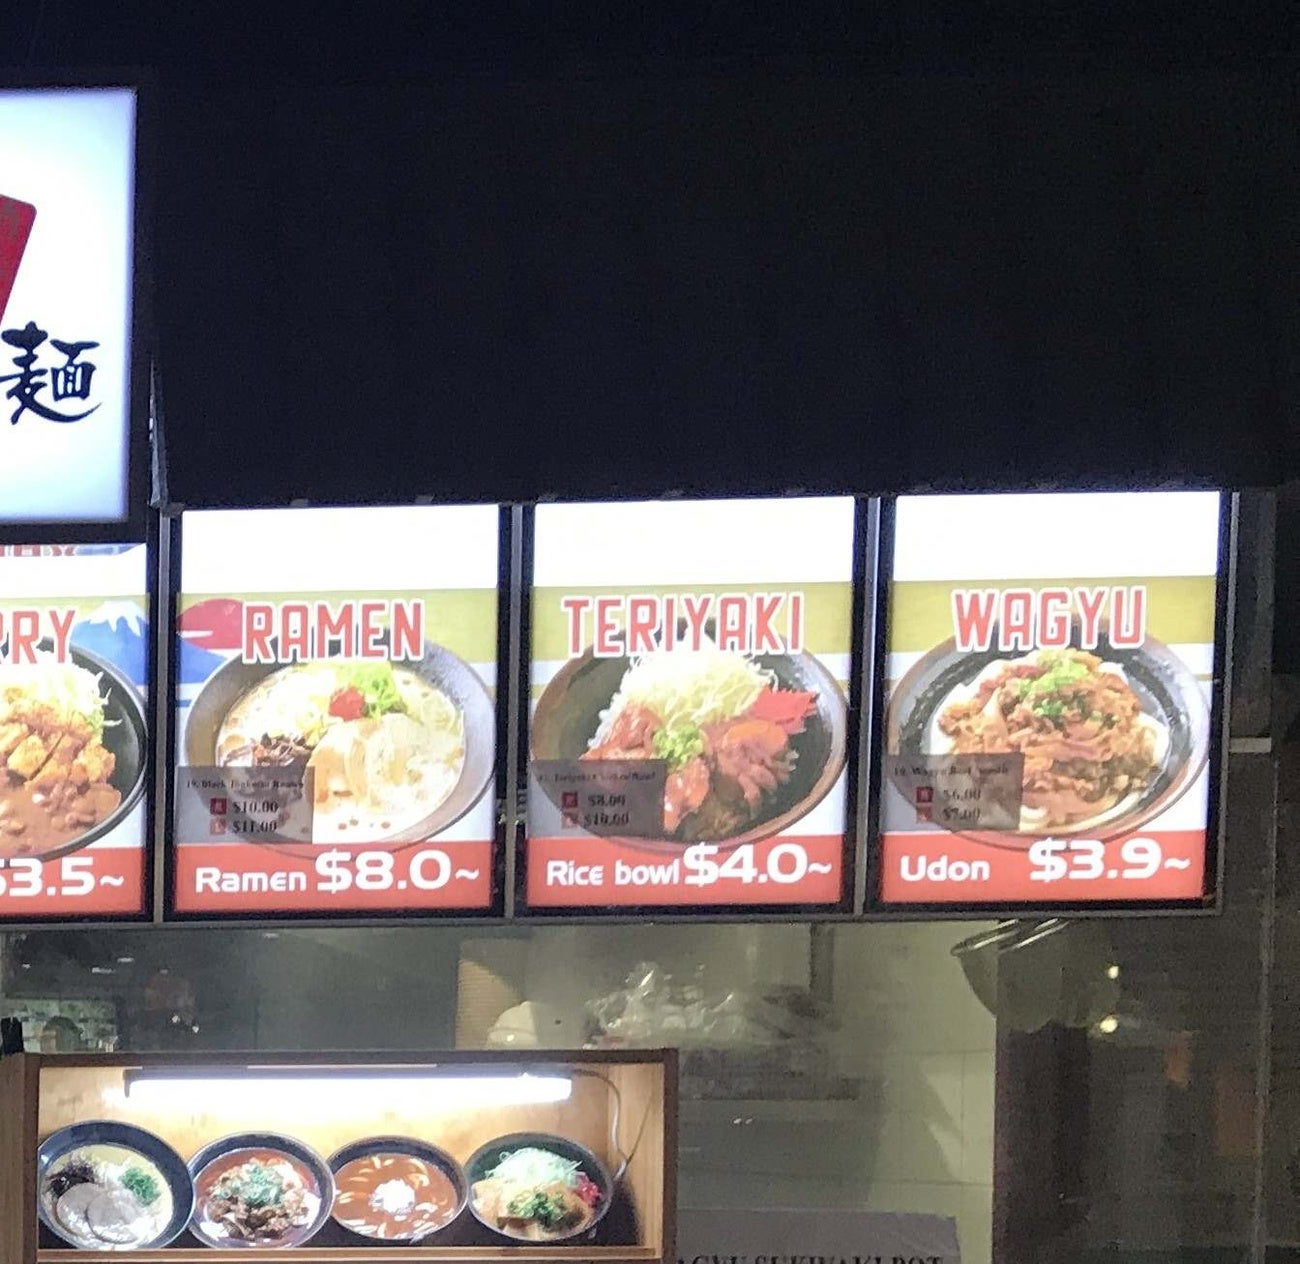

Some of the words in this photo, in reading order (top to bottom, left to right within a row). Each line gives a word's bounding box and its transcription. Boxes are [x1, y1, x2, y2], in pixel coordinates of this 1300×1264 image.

[242, 600, 424, 662] RAMEN
[561, 593, 805, 657] TERIYAKI
[953, 587, 1146, 652] WAGYU
[196, 866, 306, 893] Ramen
[546, 859, 604, 886] Rice
[615, 858, 679, 884] bowl
[901, 854, 990, 881] Udon
